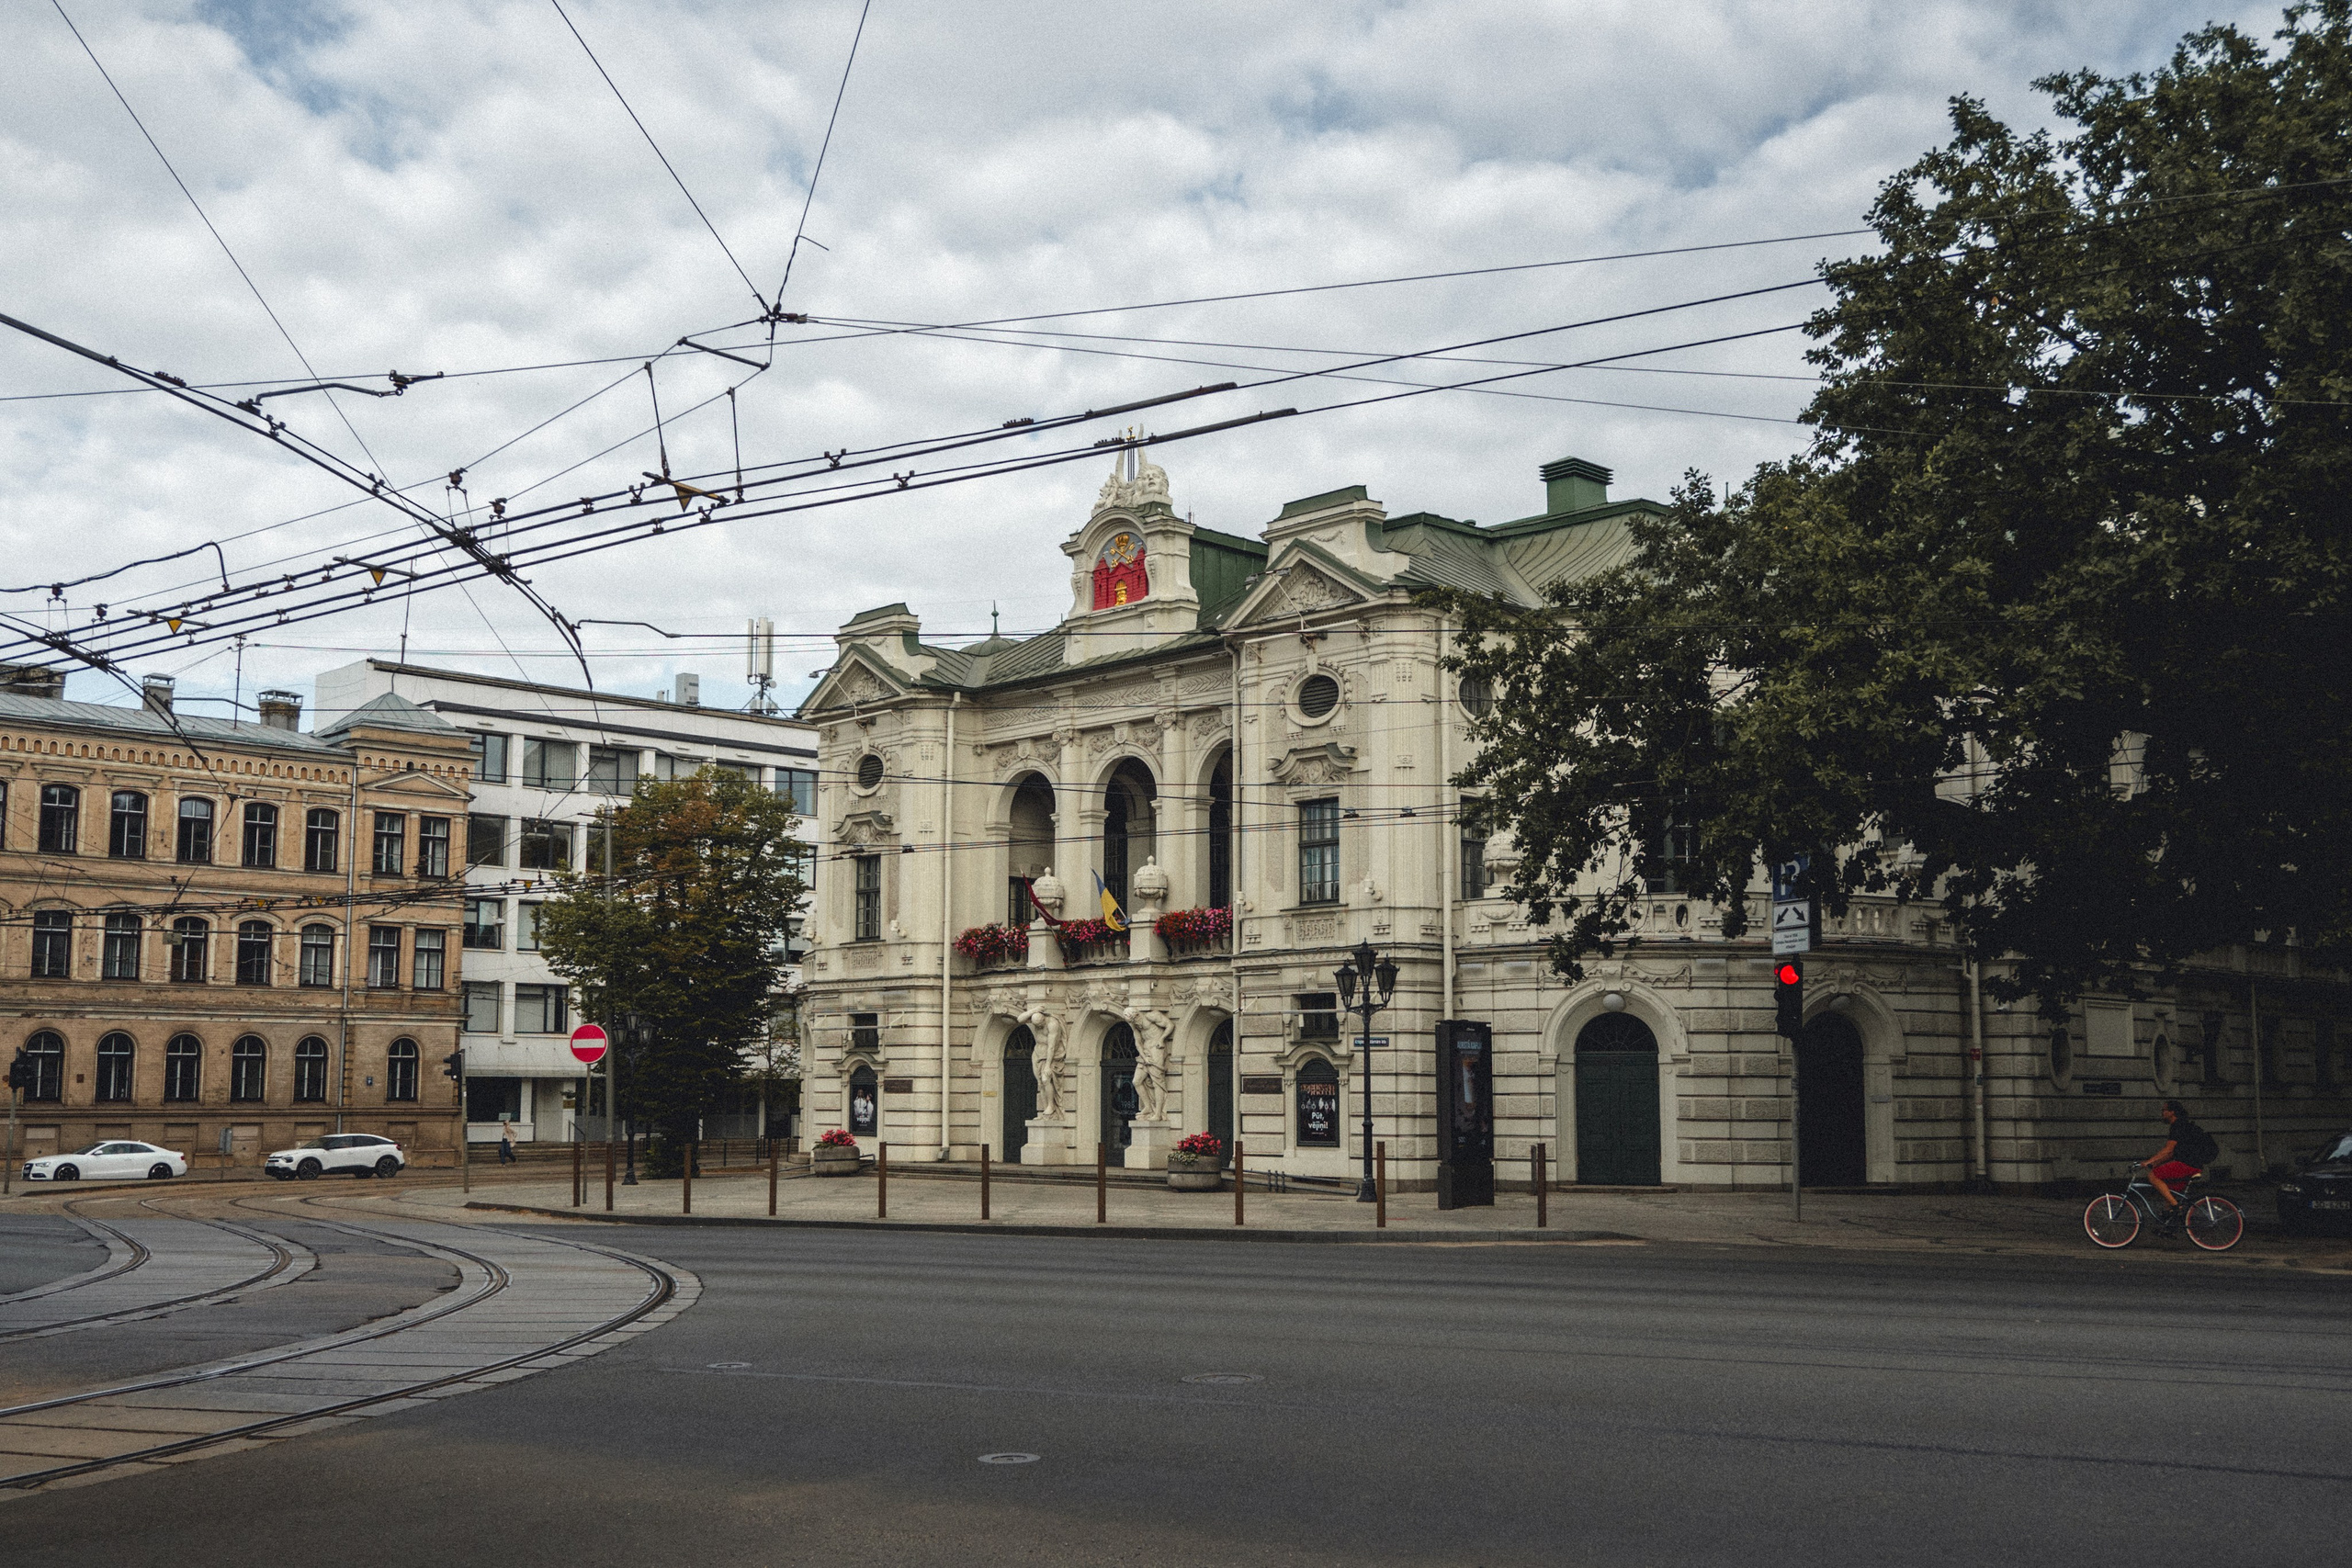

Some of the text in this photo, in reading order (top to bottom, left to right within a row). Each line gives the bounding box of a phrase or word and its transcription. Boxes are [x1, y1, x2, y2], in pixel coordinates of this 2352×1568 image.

[1781, 860, 1801, 896] P
[1311, 1111, 1325, 1121] Pūt,
[1307, 1121, 1329, 1131] vējiņi!
